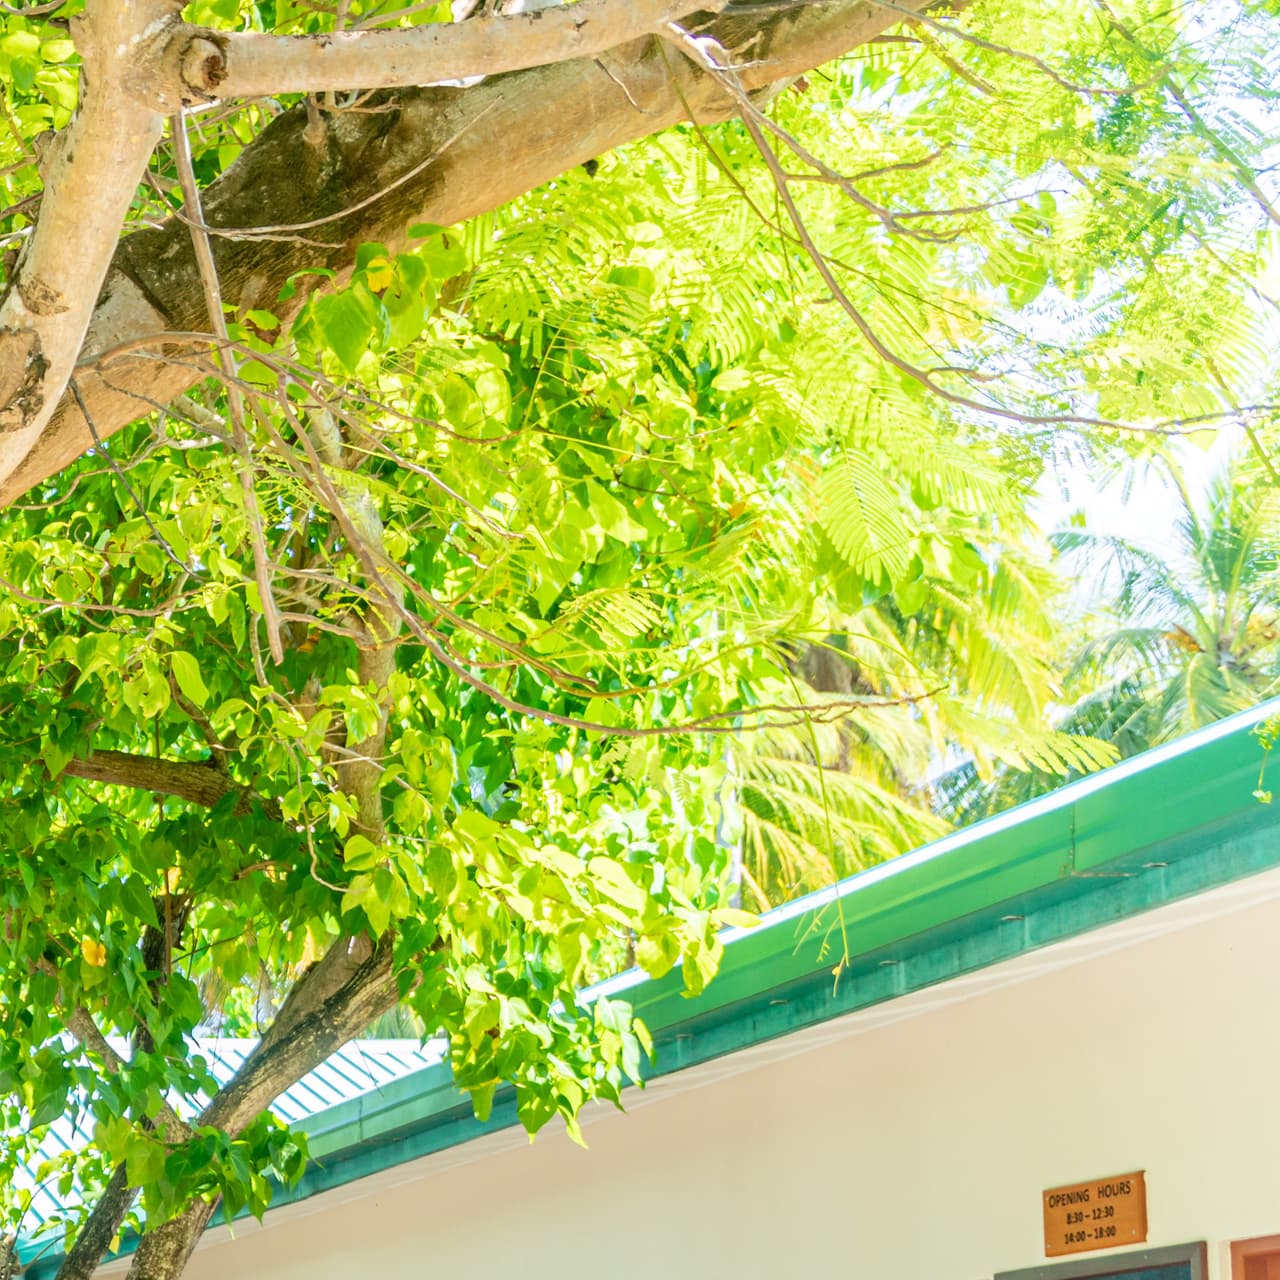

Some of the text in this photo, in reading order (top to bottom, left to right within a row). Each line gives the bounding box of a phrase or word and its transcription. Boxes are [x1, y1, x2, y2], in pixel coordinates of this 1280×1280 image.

[1048, 1180, 1131, 1208] OPENING HOURS
[1092, 1206, 1114, 1220] 12:30
[1064, 1230, 1086, 1245] 14:00
[1094, 1225, 1117, 1239] 18:00
